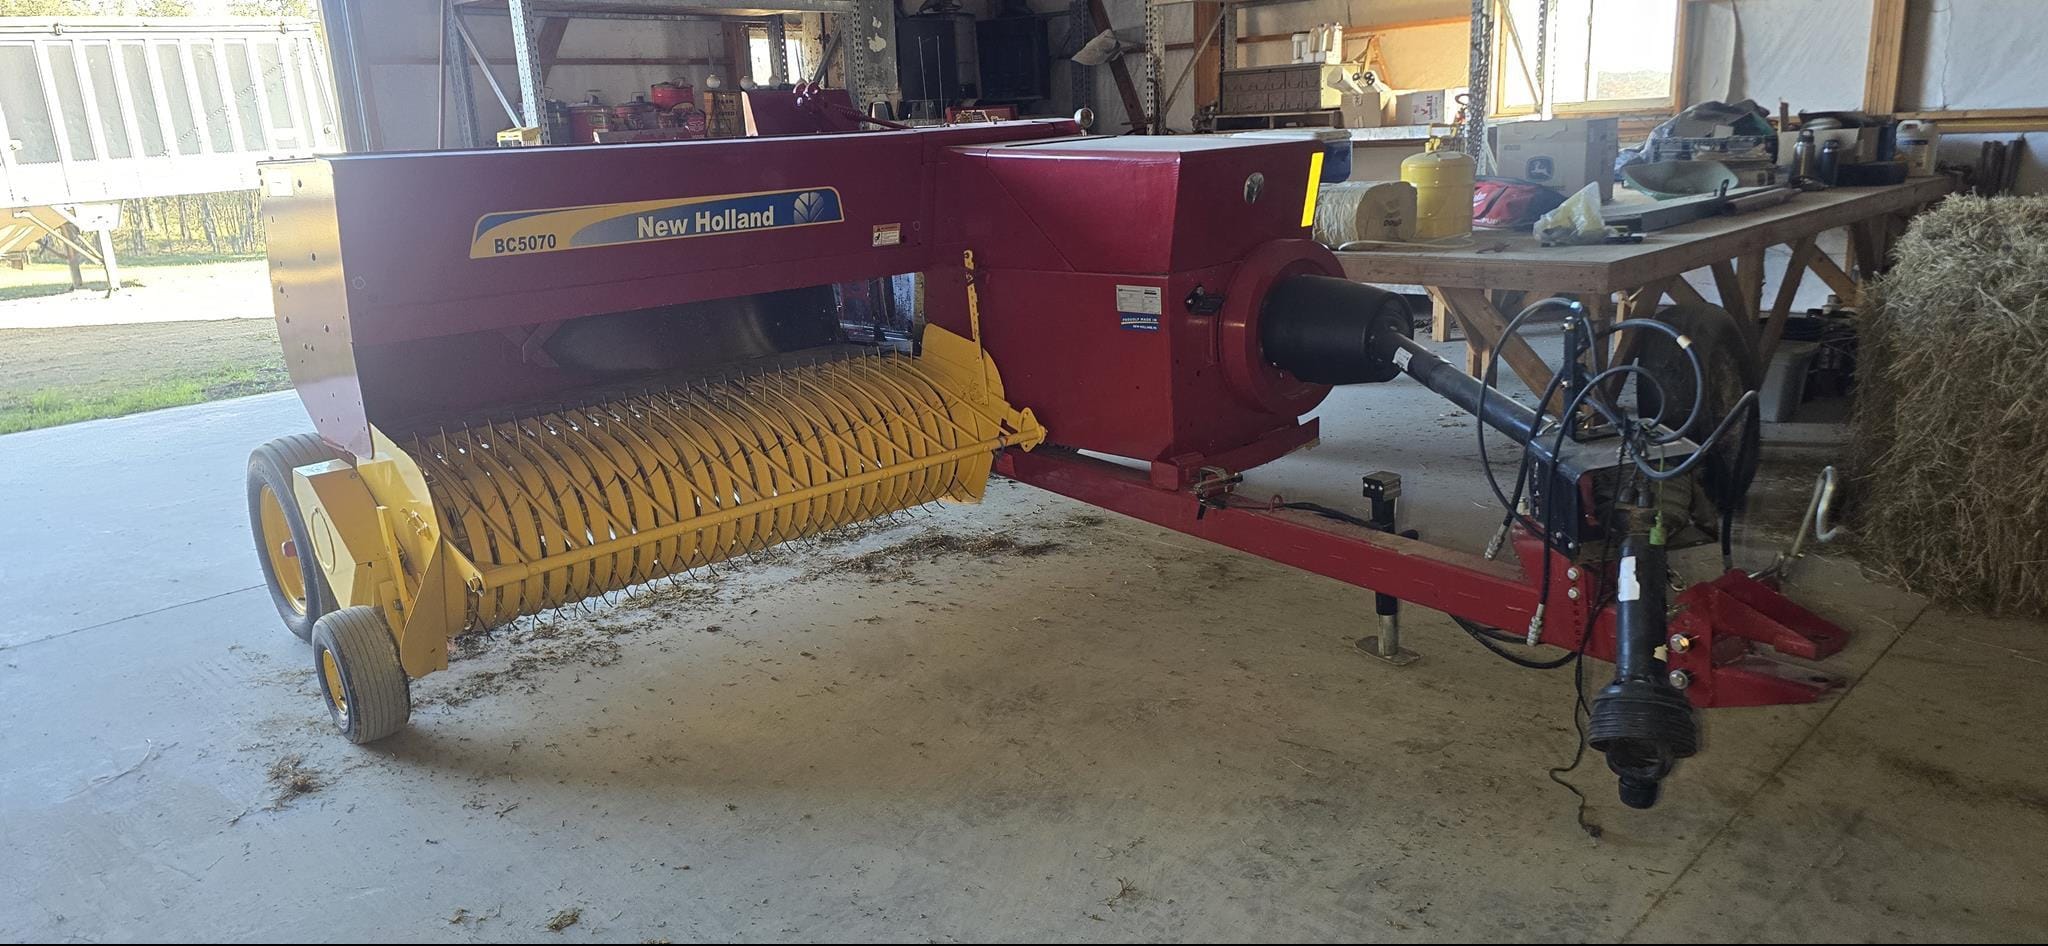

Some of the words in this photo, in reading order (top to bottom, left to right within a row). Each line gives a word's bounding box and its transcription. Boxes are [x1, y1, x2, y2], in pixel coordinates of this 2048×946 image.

[637, 215, 689, 239] New
[695, 205, 774, 233] Holland
[494, 233, 557, 254] BC5070
